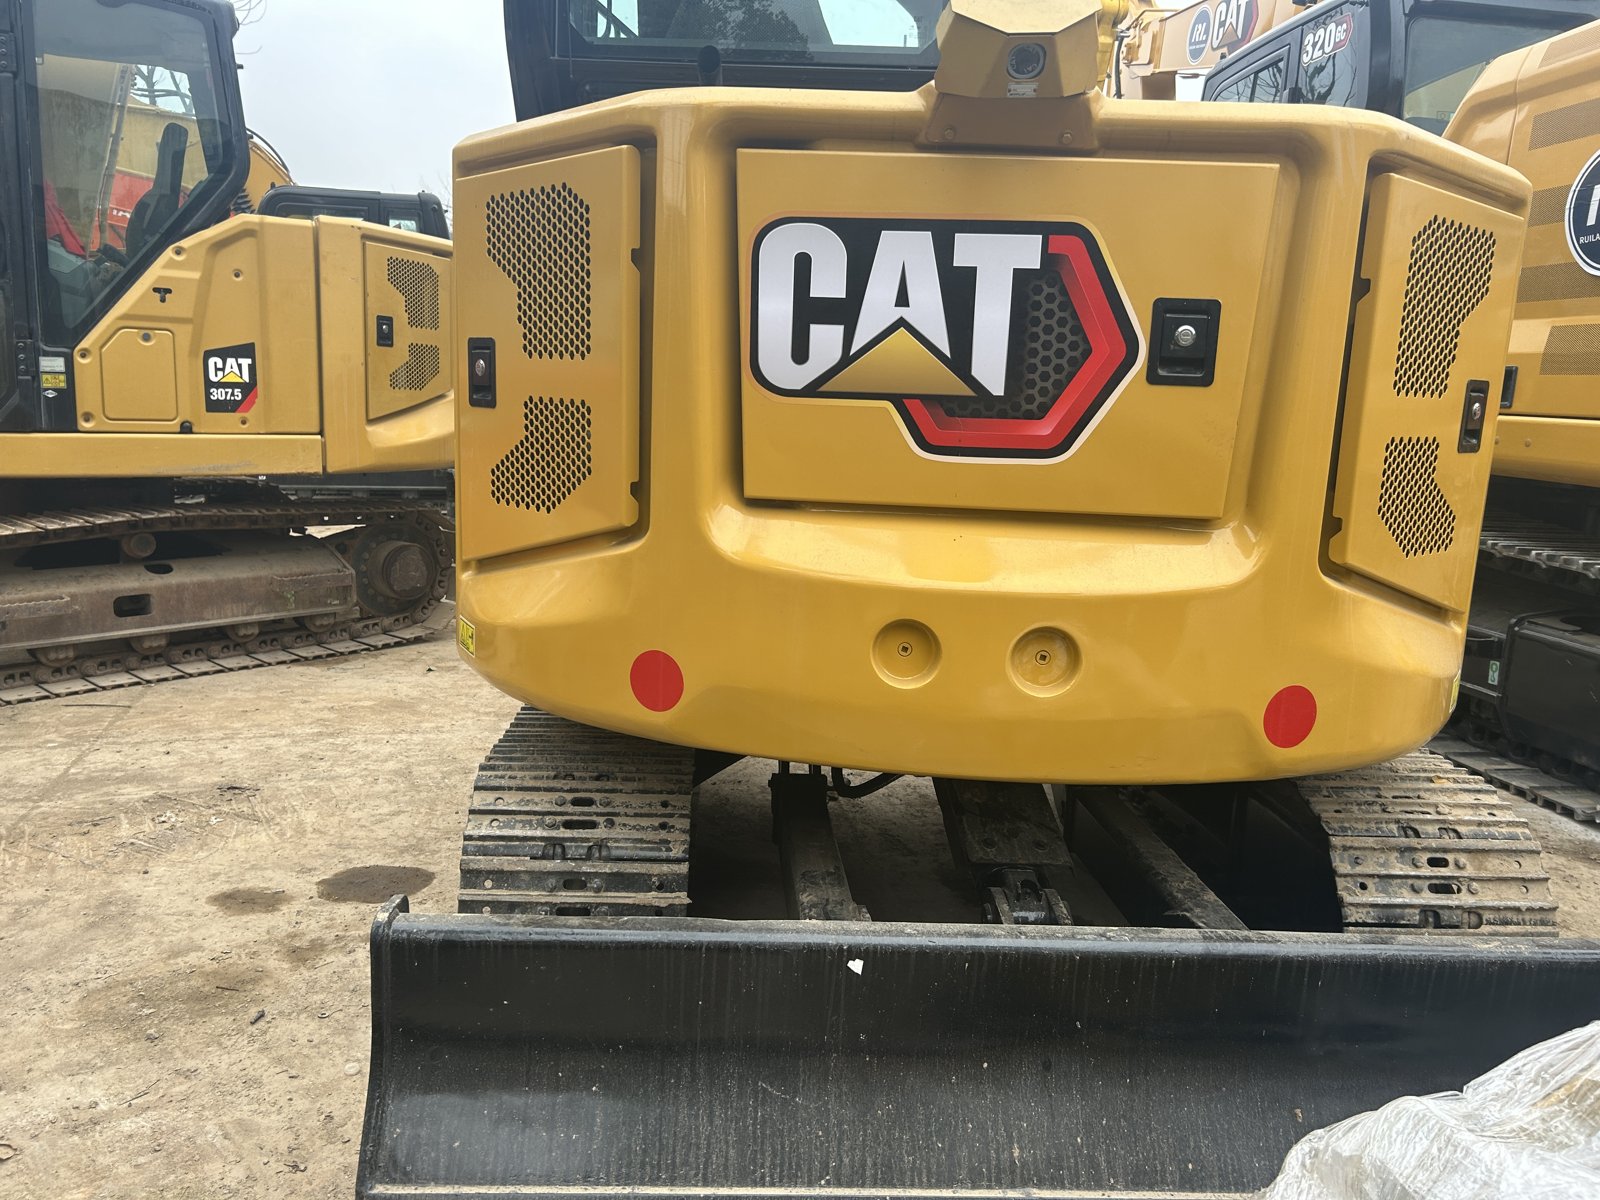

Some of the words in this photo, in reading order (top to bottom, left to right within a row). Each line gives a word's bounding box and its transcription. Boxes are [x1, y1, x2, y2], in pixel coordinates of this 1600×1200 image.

[1212, 0, 1248, 49] CAT
[1302, 22, 1336, 63] 320
[757, 222, 1043, 396] CAT
[208, 356, 252, 383] CAT
[209, 387, 242, 401] 307.5
